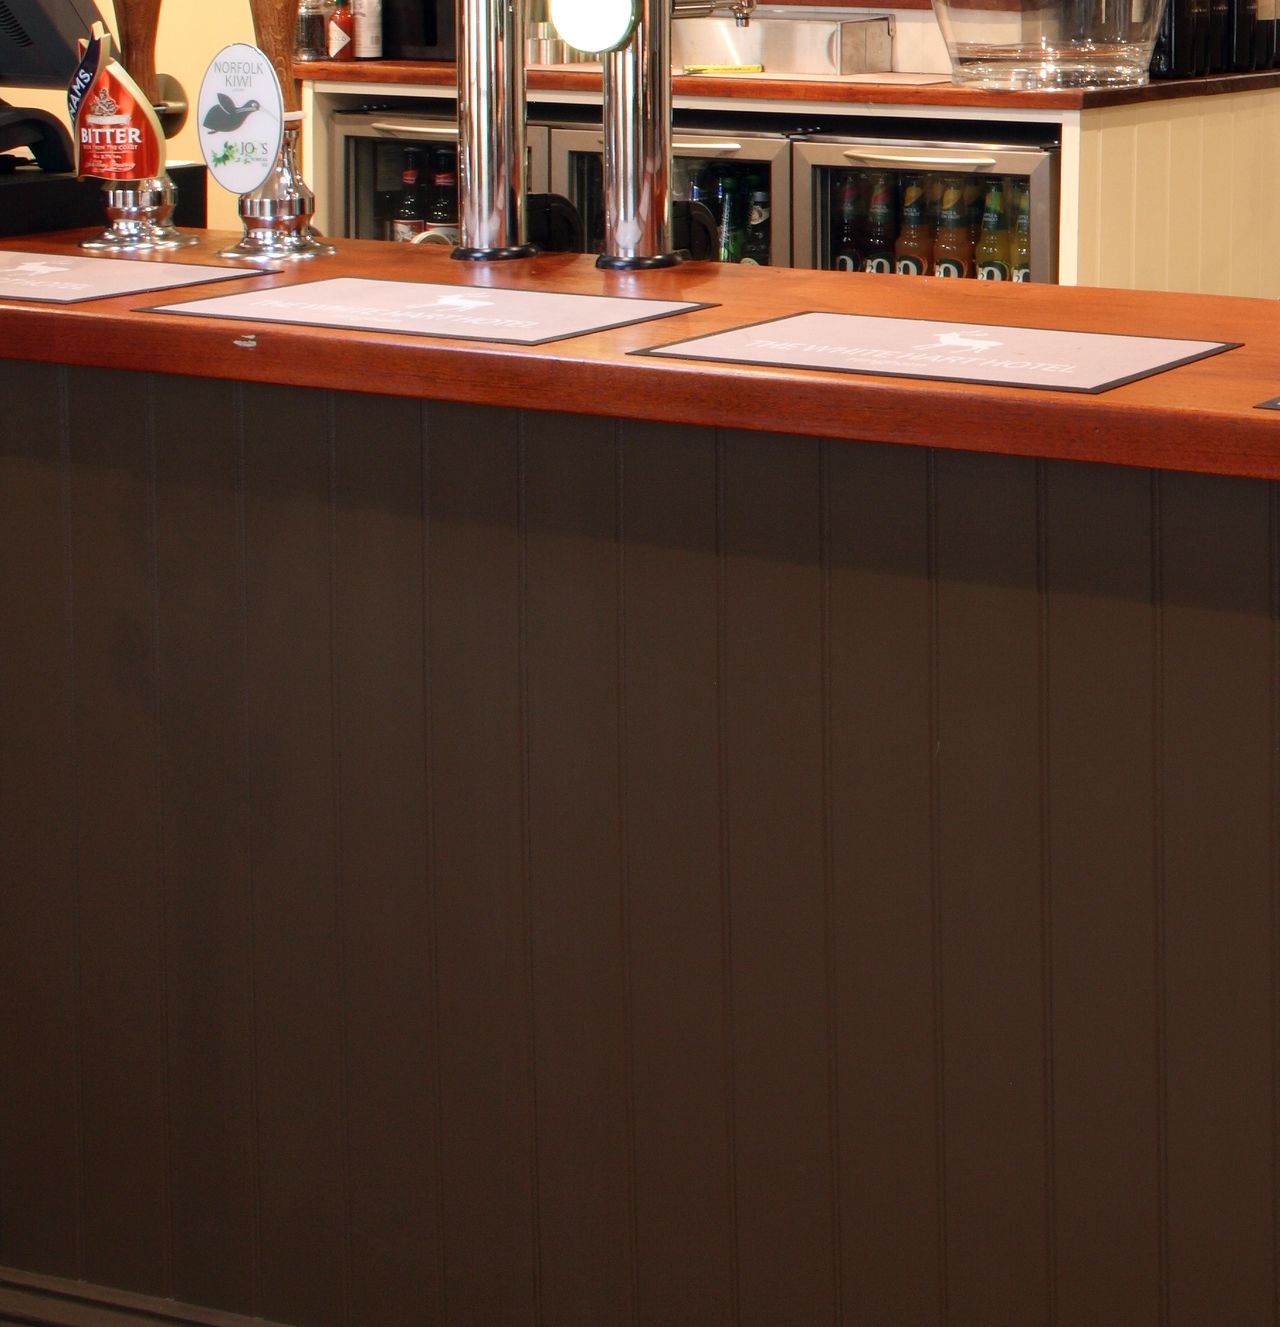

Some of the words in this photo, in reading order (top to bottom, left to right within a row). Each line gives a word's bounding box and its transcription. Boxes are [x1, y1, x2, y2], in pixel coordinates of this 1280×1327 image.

[214, 61, 263, 74] NORFOLK
[225, 75, 252, 88] KIWI
[81, 127, 143, 144] BITTER
[746, 339, 805, 351] THE
[805, 344, 895, 359] WHITE
[897, 351, 982, 364] HART
[982, 359, 1077, 373] HOTEL
